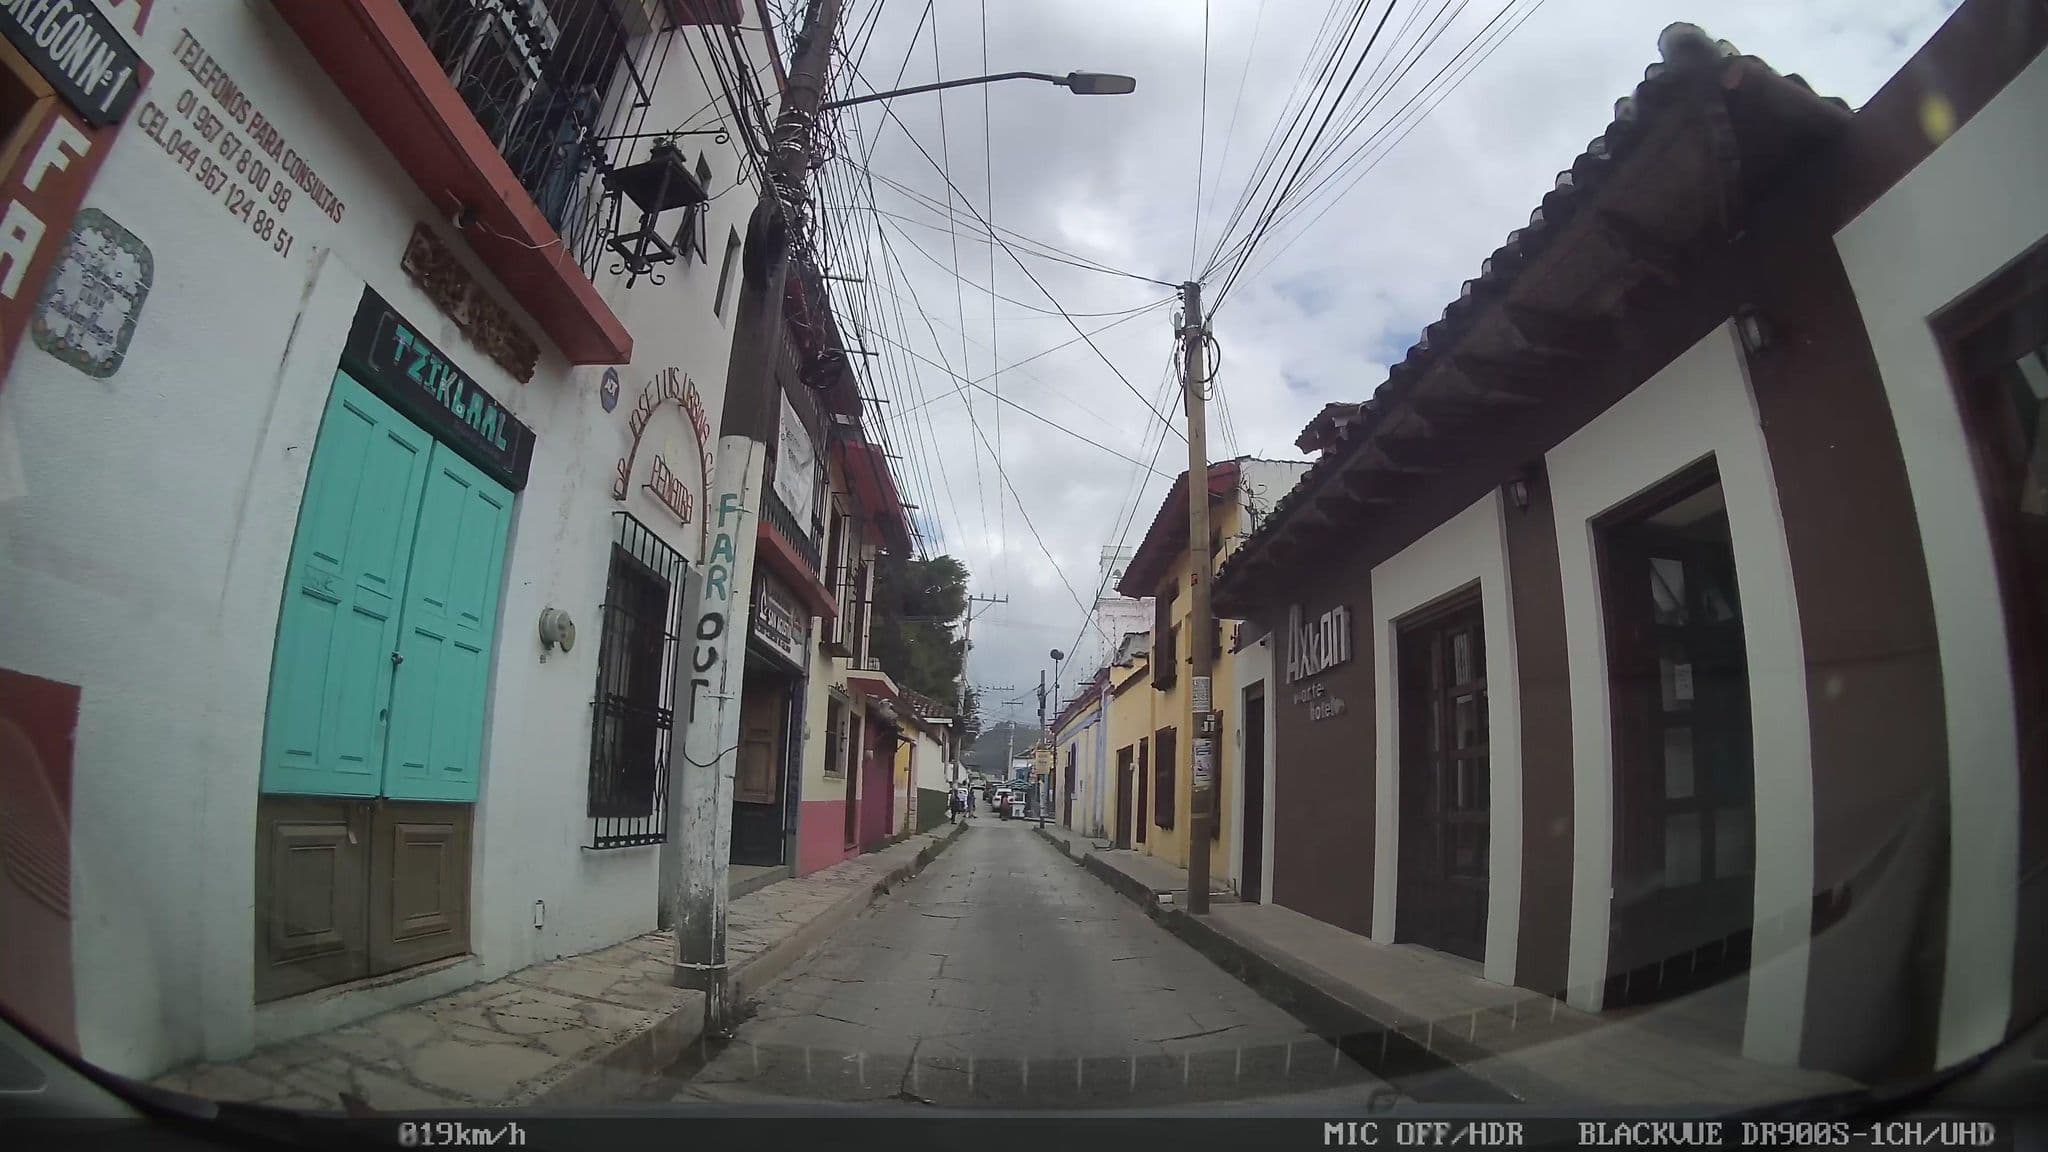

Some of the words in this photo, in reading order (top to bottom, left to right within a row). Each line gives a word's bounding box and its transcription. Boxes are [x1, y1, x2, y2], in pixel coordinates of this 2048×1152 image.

[172, 27, 252, 125] TELEFONOS
[246, 111, 285, 164] PARA
[282, 148, 345, 224] CONSULTAS
[196, 156, 229, 195] 967
[224, 183, 256, 224] 124
[253, 209, 275, 242] 88
[274, 227, 294, 259] 51
[248, 160, 271, 193] 00
[268, 180, 292, 213] 98
[705, 493, 738, 602] FAR
[689, 611, 726, 724] OUT
